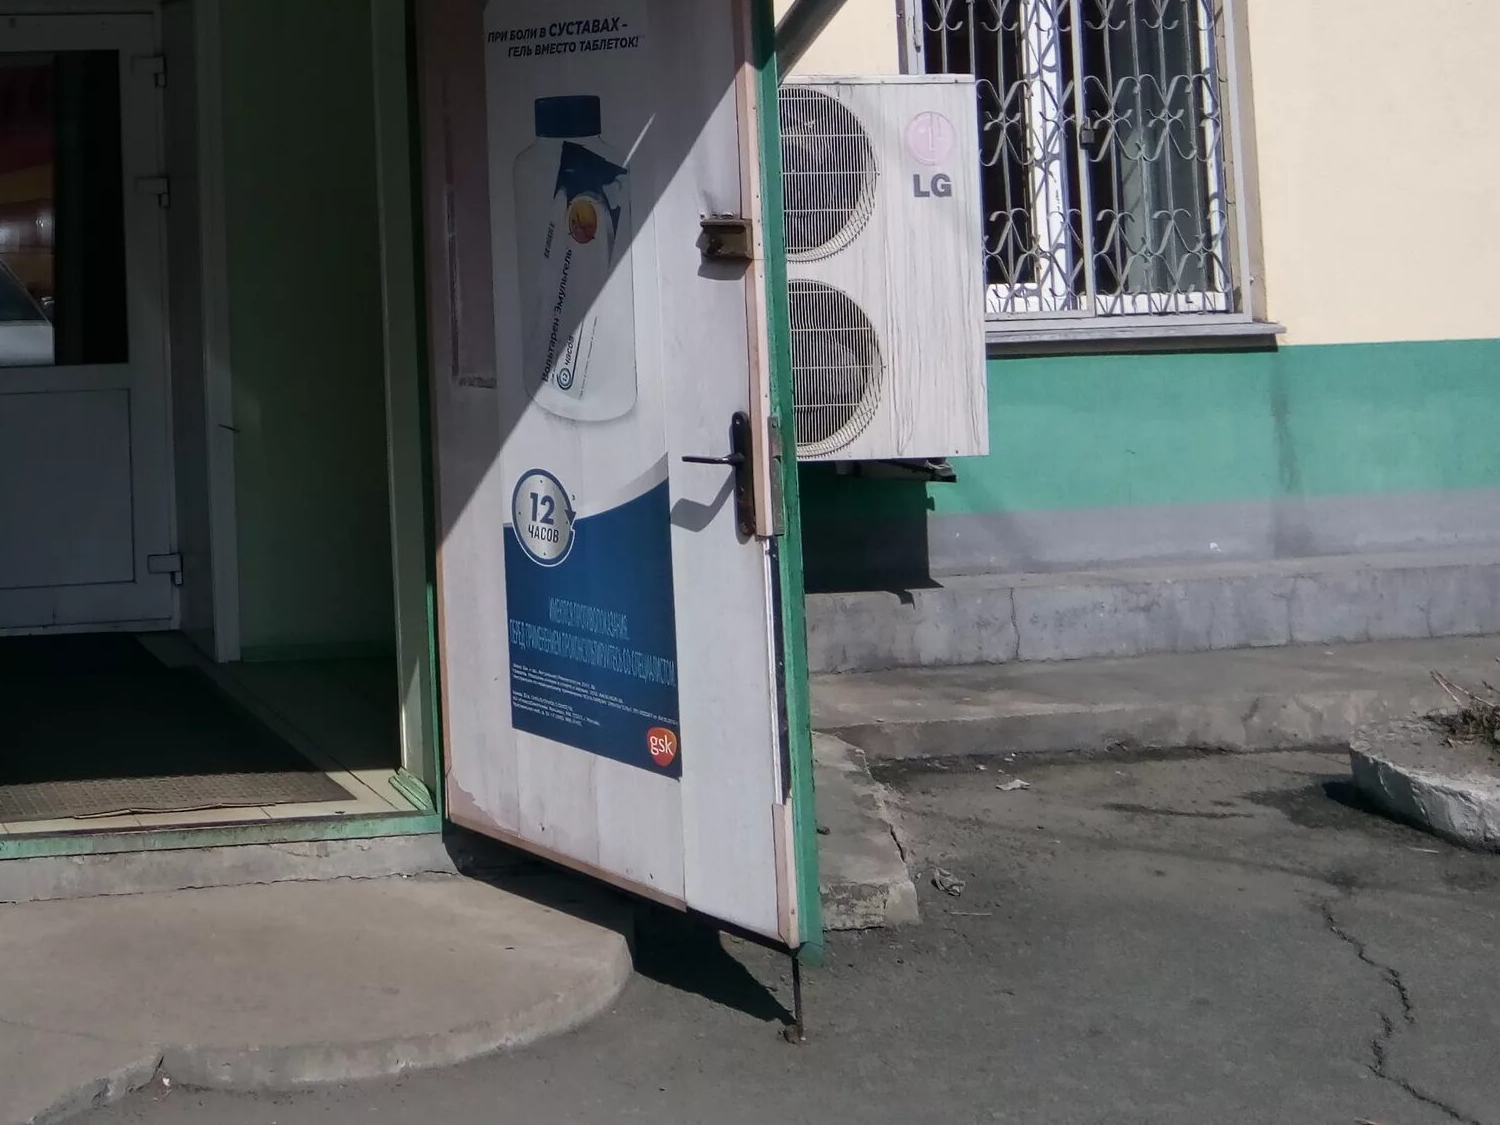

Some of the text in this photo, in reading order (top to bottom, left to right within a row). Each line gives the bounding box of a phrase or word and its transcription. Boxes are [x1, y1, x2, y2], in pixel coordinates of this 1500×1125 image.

[487, 31, 508, 43] ПРИ
[509, 28, 538, 41] БОЛИ
[539, 27, 546, 38] В
[549, 17, 620, 37] СУСТАВАХ
[508, 36, 639, 58] ГЕЛЬ ВМЕСТО ТАБЛЕТОК!
[912, 173, 952, 197] LG
[554, 249, 572, 314] Эмульгель
[530, 492, 556, 525] 12
[528, 524, 559, 543] ЧАСОВ
[650, 735, 674, 756] gsk
